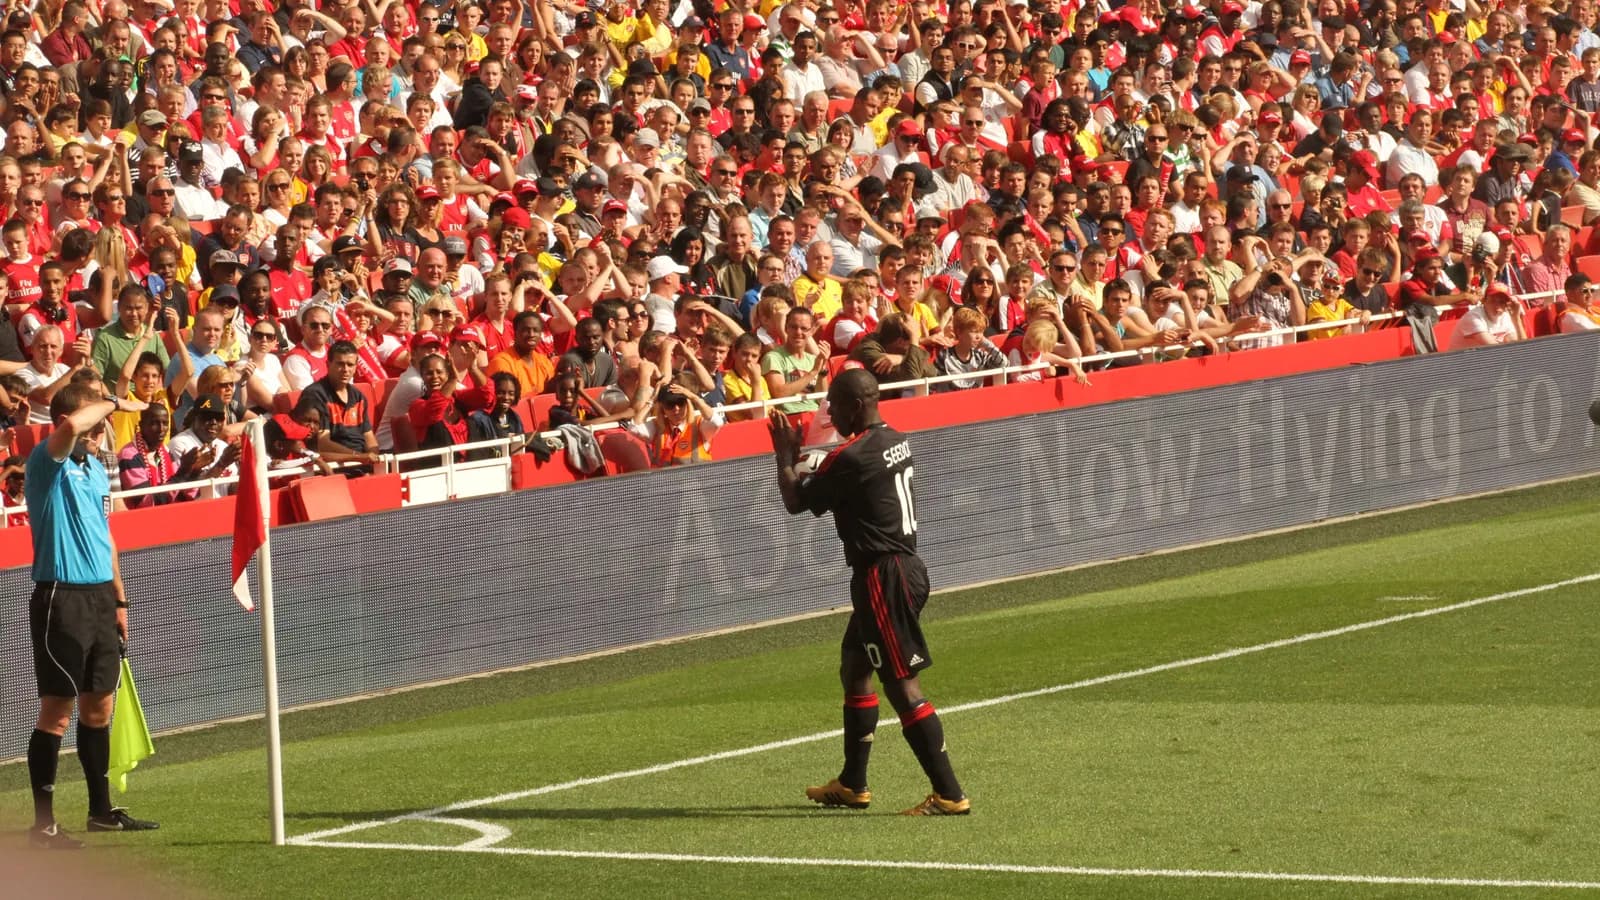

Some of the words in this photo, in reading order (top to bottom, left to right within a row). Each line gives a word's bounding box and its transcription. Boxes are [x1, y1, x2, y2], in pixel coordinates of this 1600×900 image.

[882, 440, 911, 468] SEEDO
[1018, 419, 1201, 543] Now
[1231, 373, 1461, 520] flying
[1494, 365, 1562, 459] to
